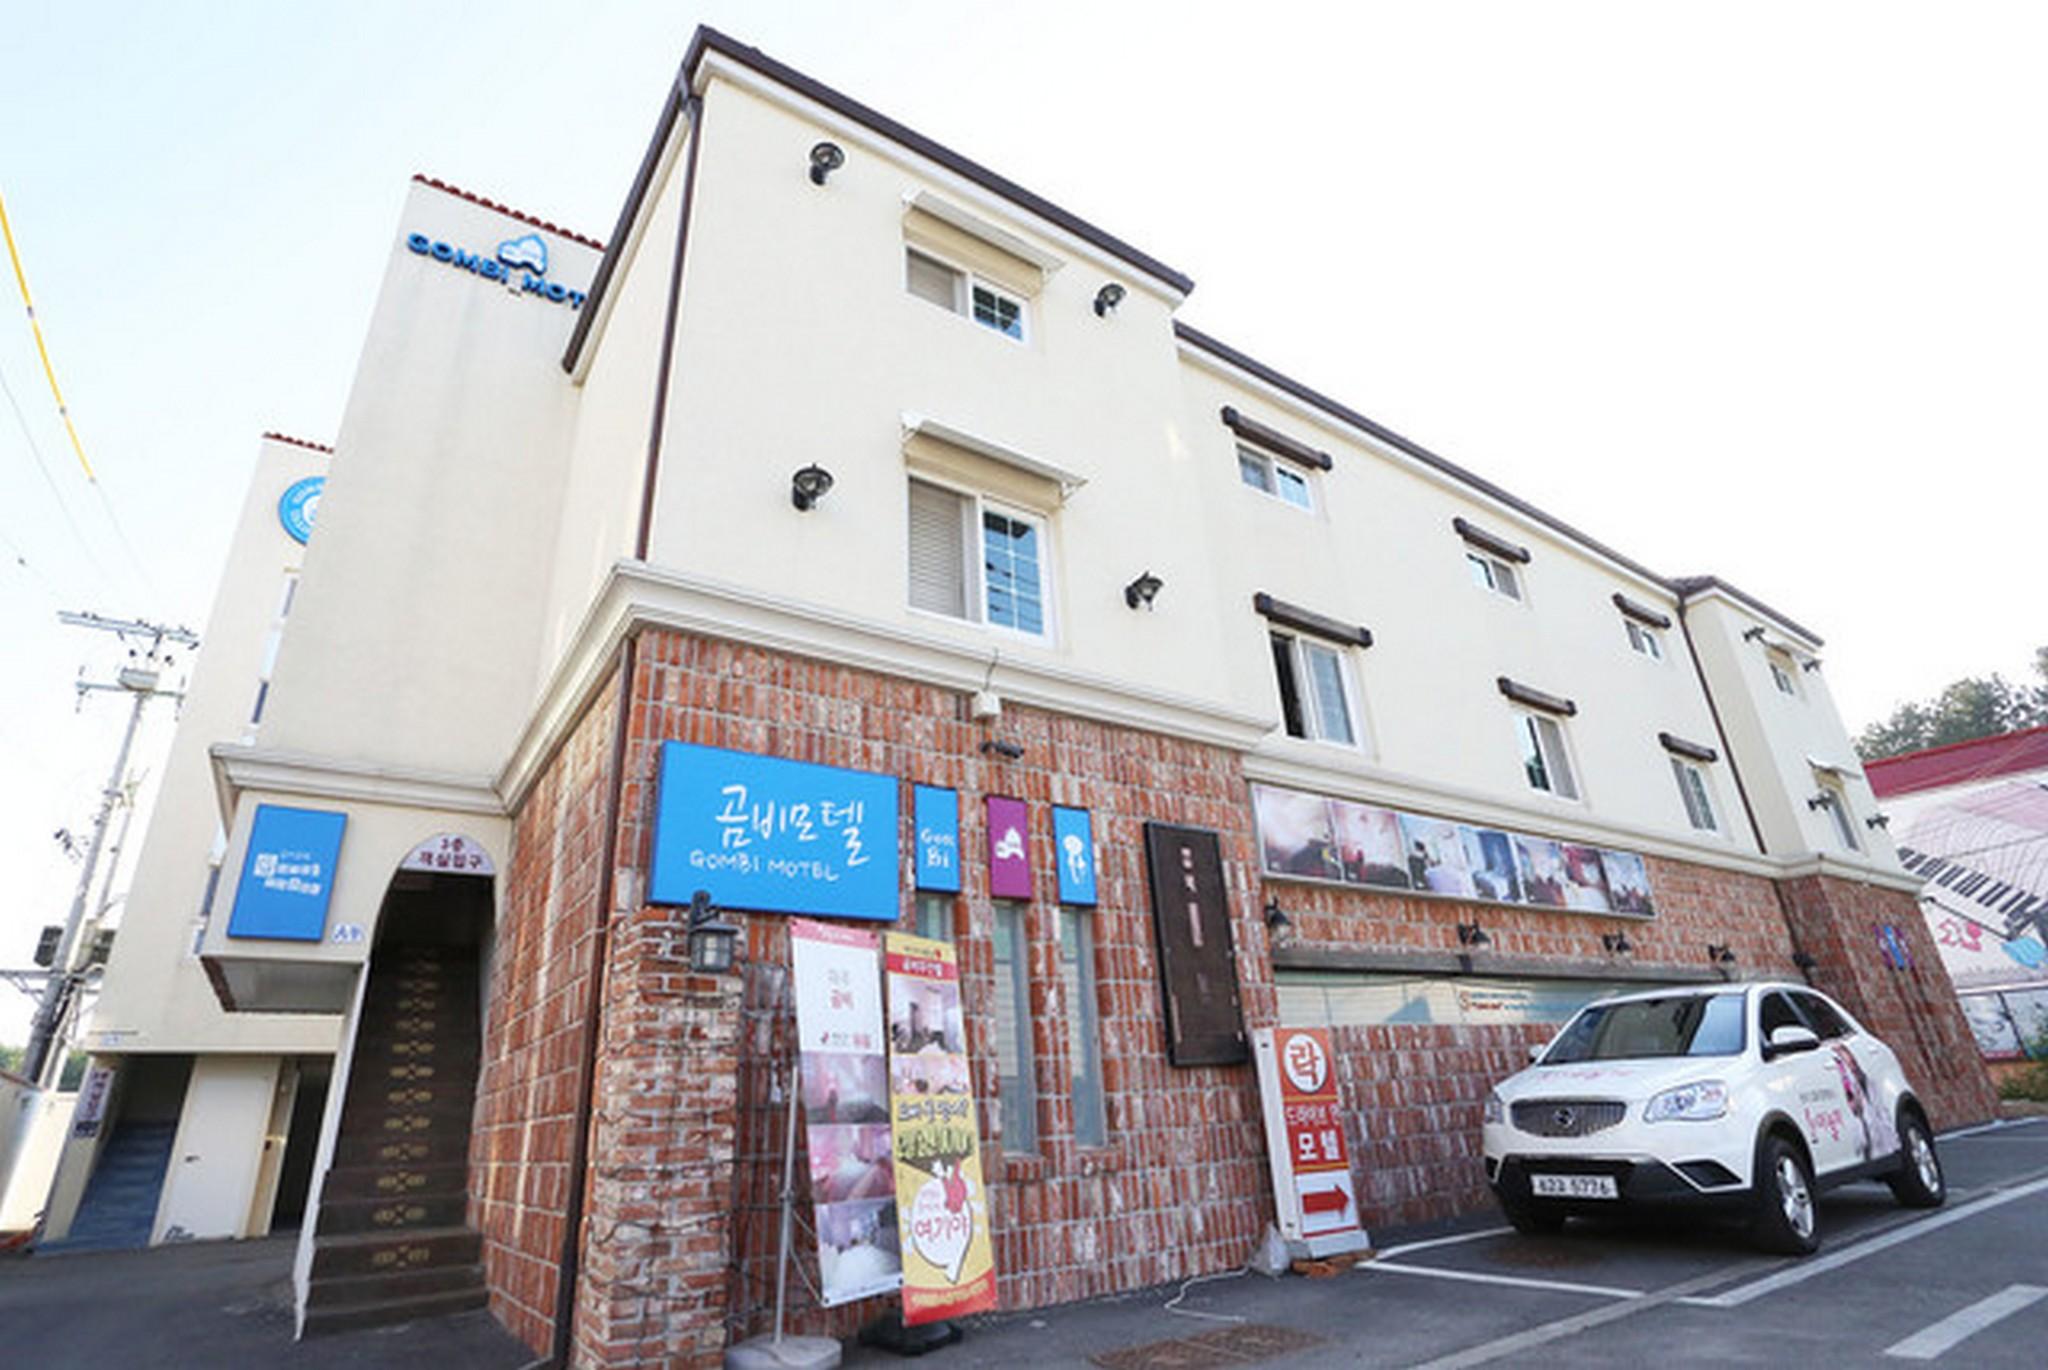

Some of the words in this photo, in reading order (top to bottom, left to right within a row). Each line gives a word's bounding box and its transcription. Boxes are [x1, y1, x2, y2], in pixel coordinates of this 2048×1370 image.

[407, 232, 511, 285] GOMBI
[715, 784, 870, 867] 곰비모텔
[689, 849, 760, 874] GOMBI
[767, 858, 840, 882] MOTEL
[928, 847, 949, 867] Bi
[1298, 1130, 1341, 1161] 모텔
